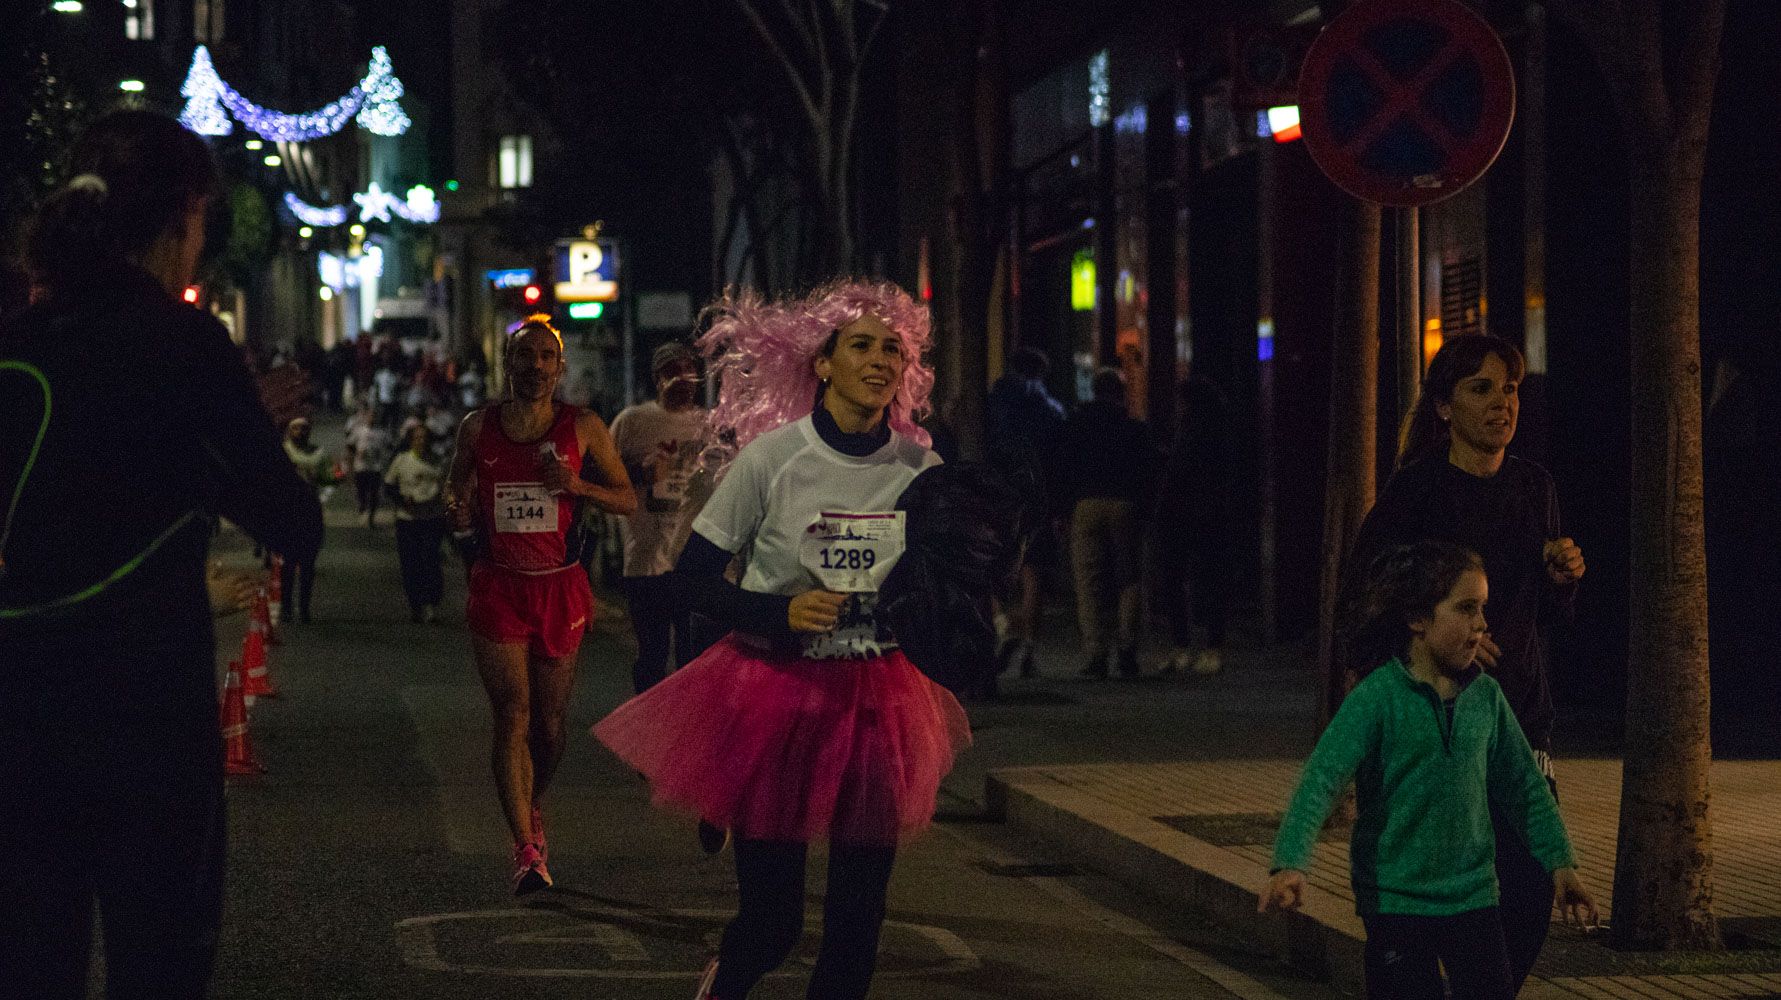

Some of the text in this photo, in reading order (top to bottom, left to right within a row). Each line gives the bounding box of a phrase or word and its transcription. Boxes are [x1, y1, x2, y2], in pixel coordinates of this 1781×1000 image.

[569, 240, 603, 284] P
[506, 505, 545, 520] 1144
[819, 548, 876, 570] 1289
